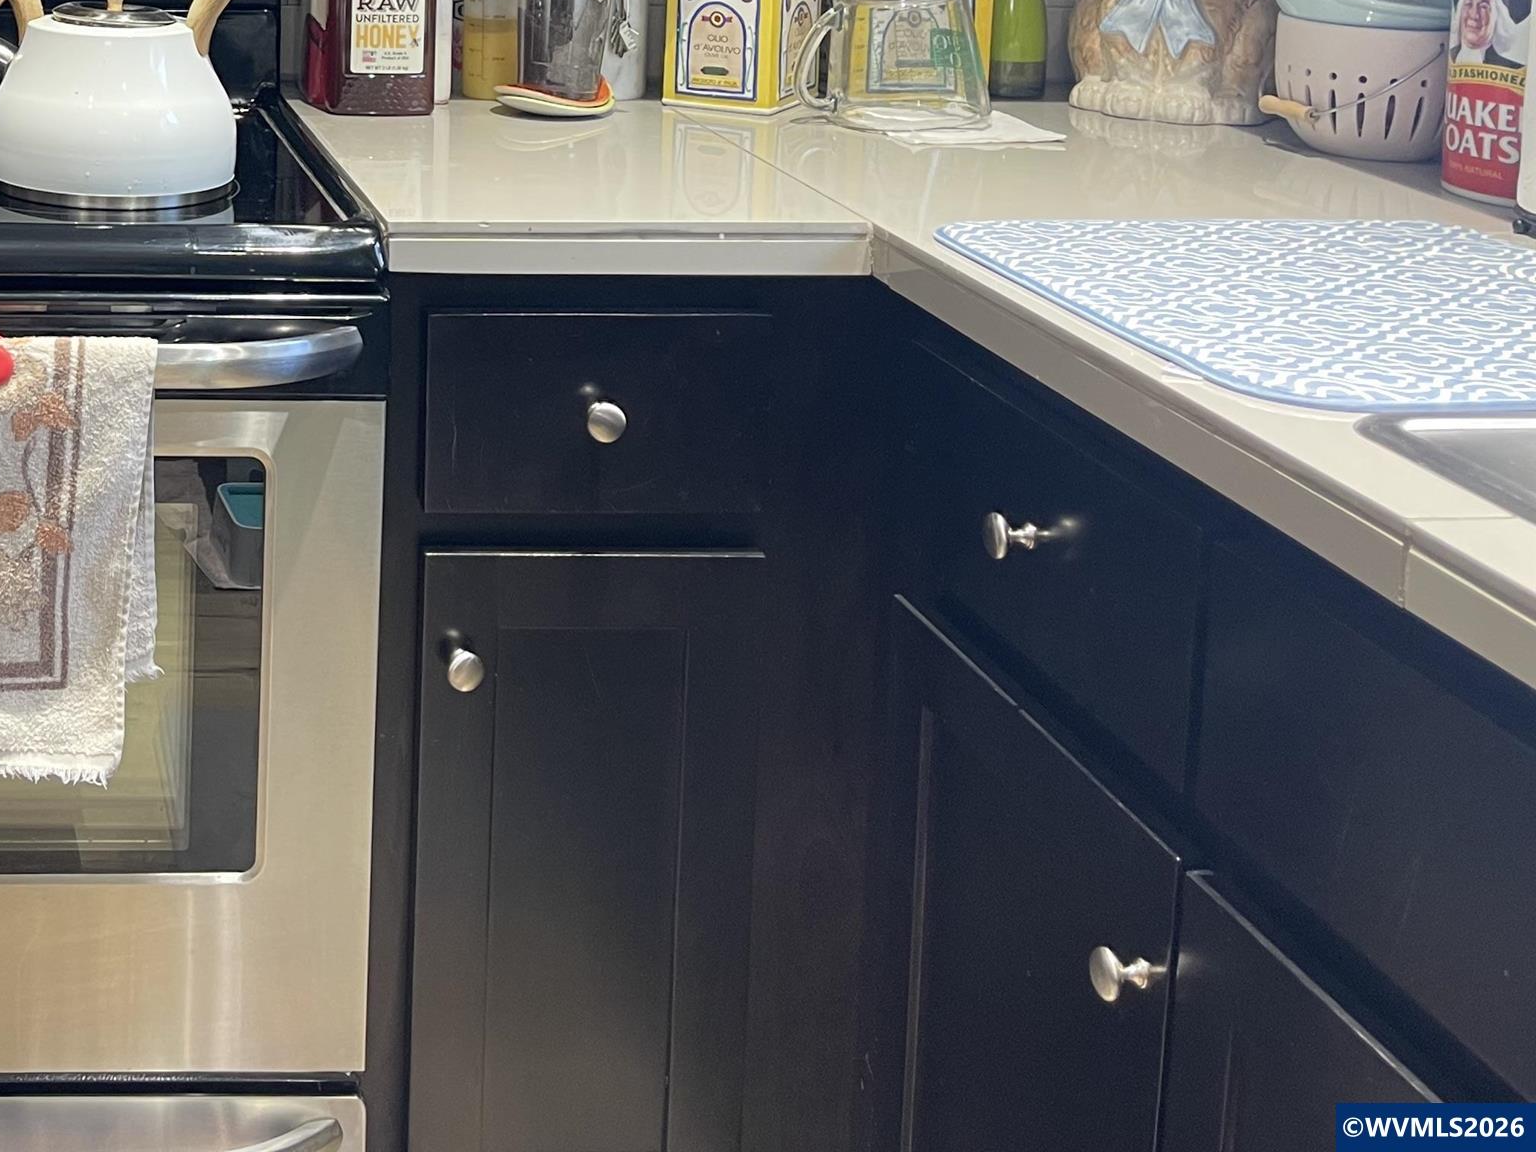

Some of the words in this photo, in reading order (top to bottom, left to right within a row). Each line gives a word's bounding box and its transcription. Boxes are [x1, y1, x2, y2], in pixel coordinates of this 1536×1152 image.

[355, 14, 420, 23] UNFILTERED
[355, 23, 421, 48] HONEY
[1445, 91, 1522, 132] UAKE
[1445, 123, 1520, 164] OATS
